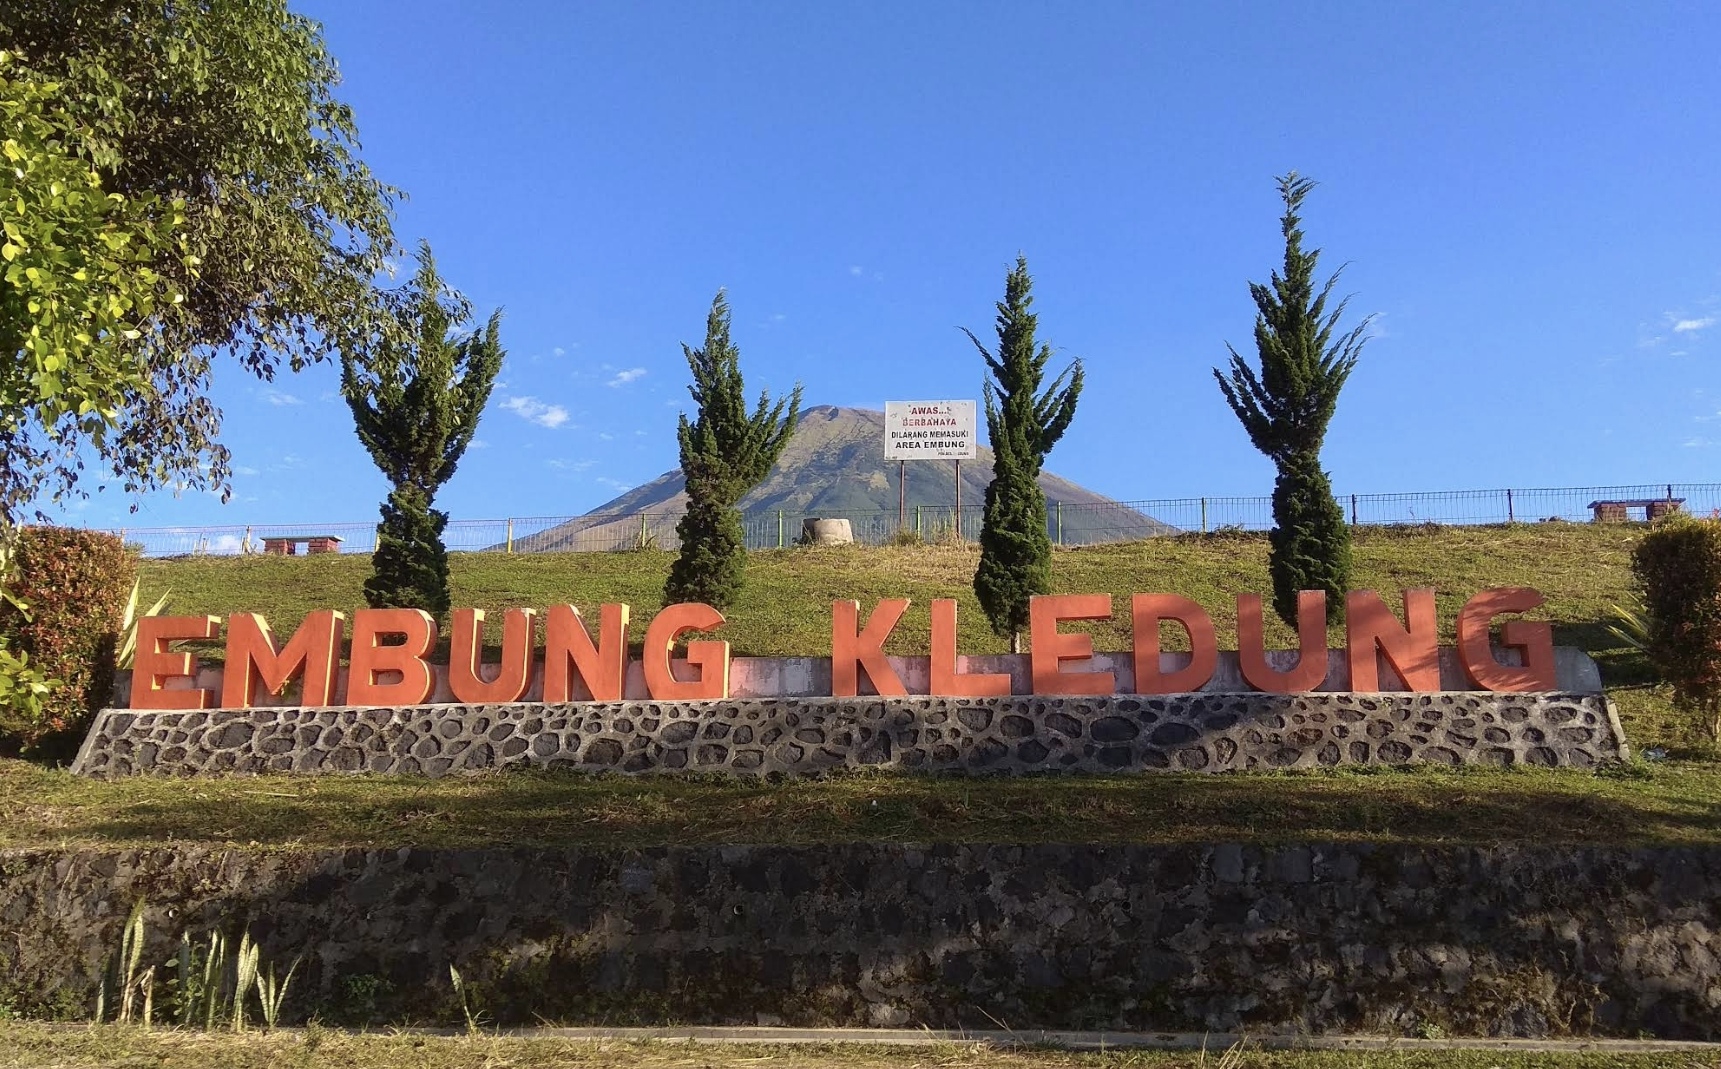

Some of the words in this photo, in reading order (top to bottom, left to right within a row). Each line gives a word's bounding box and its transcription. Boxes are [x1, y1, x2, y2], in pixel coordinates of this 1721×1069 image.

[903, 418, 957, 427] BERBAHAYA
[891, 431, 928, 439] DILARANG
[929, 430, 969, 438] MEMASUKI
[895, 441, 921, 449] AREA
[129, 602, 731, 710] EMBUNG
[831, 587, 1558, 697] KLEDUNG
